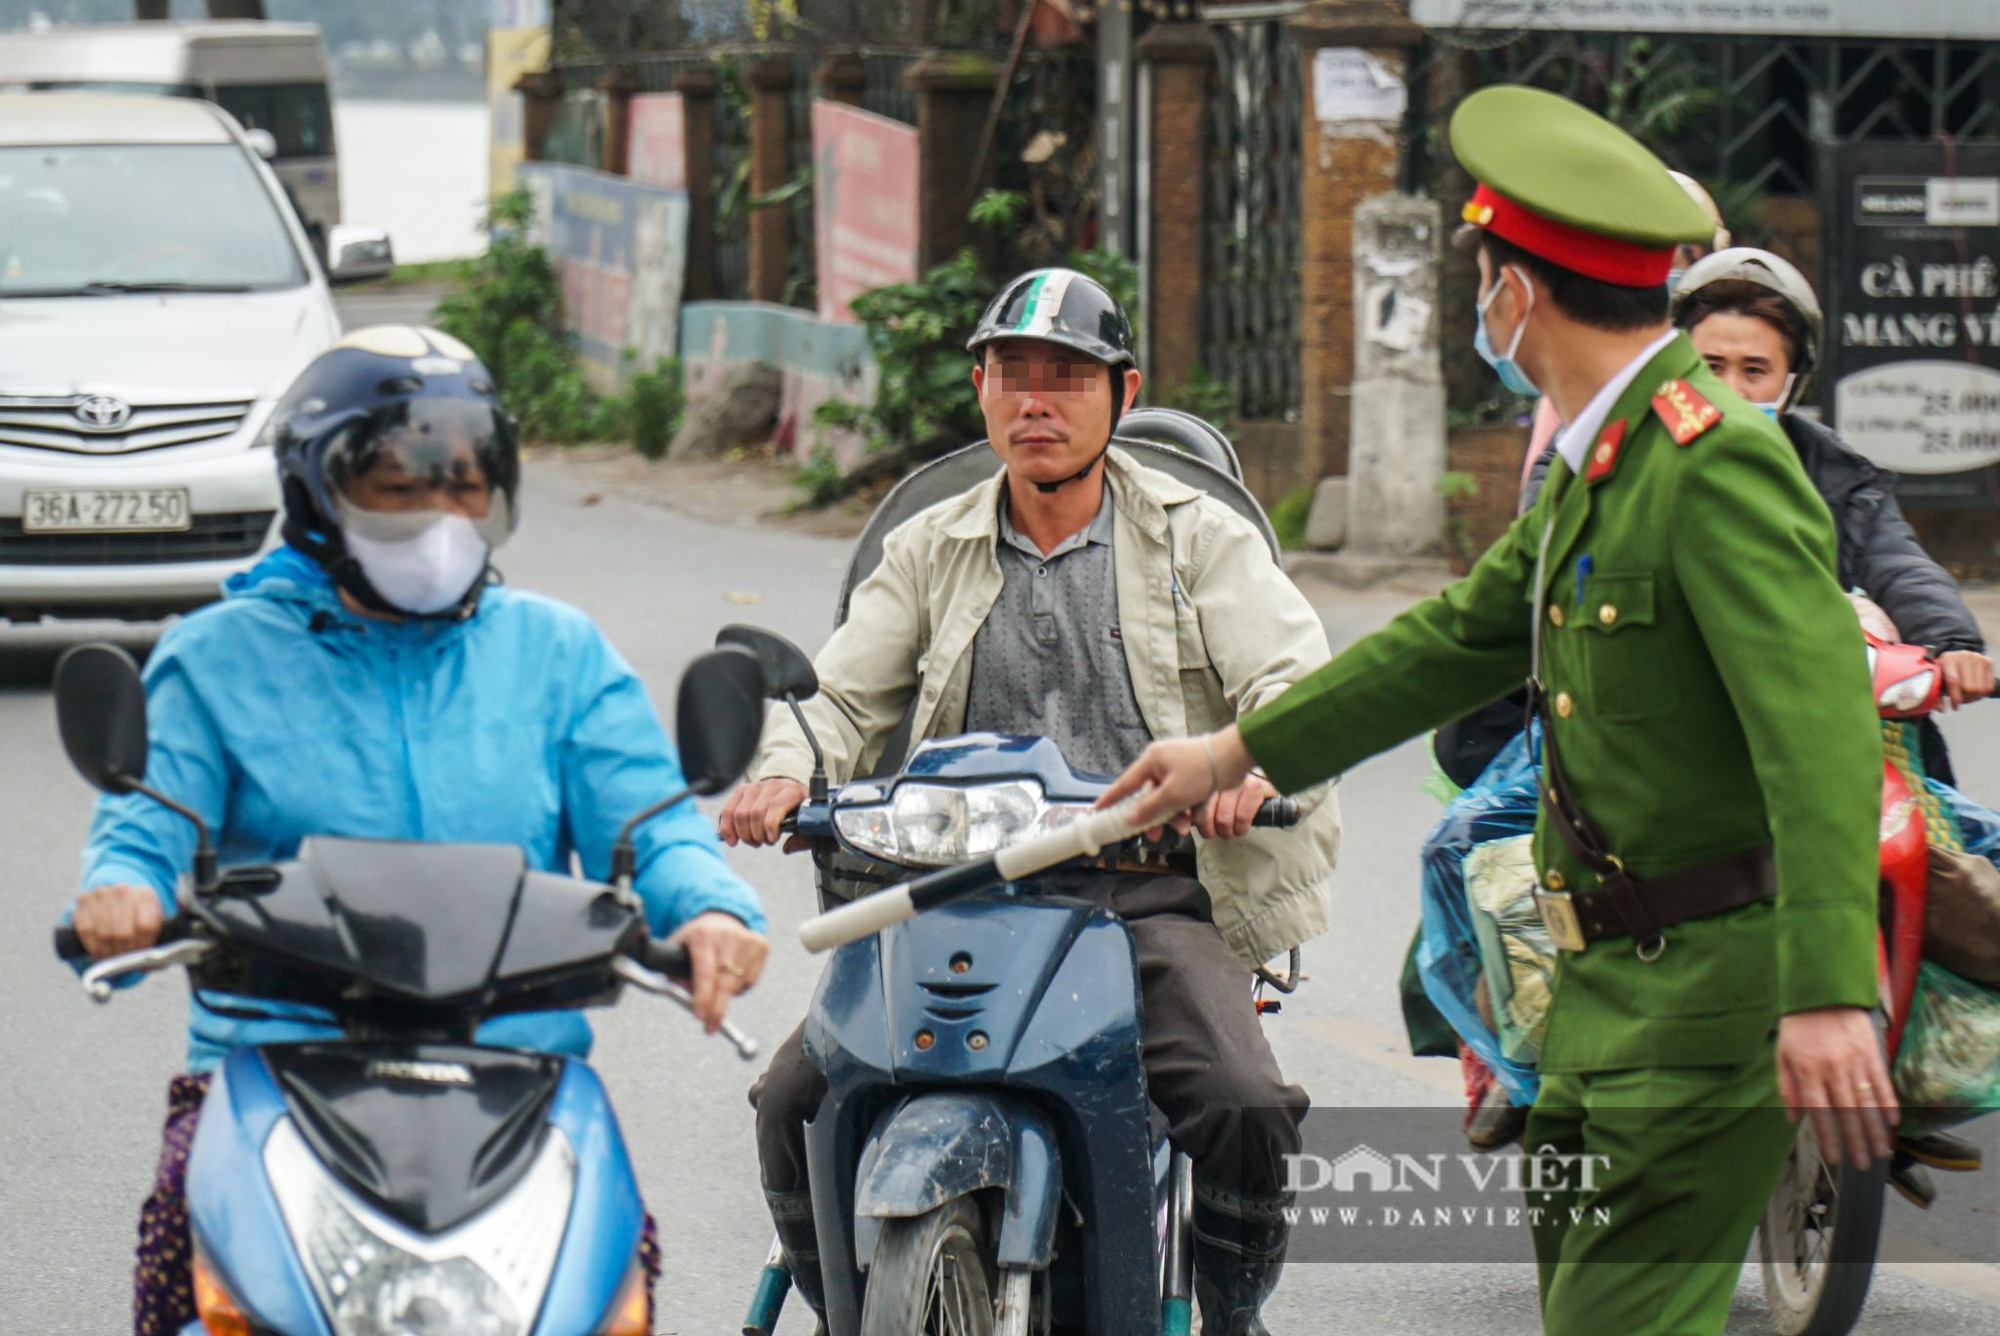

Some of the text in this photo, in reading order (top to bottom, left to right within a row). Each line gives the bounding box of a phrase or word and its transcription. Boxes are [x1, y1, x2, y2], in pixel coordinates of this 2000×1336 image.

[1860, 254, 1998, 298] CÀ PHÊ
[1842, 312, 1956, 348] MANG
